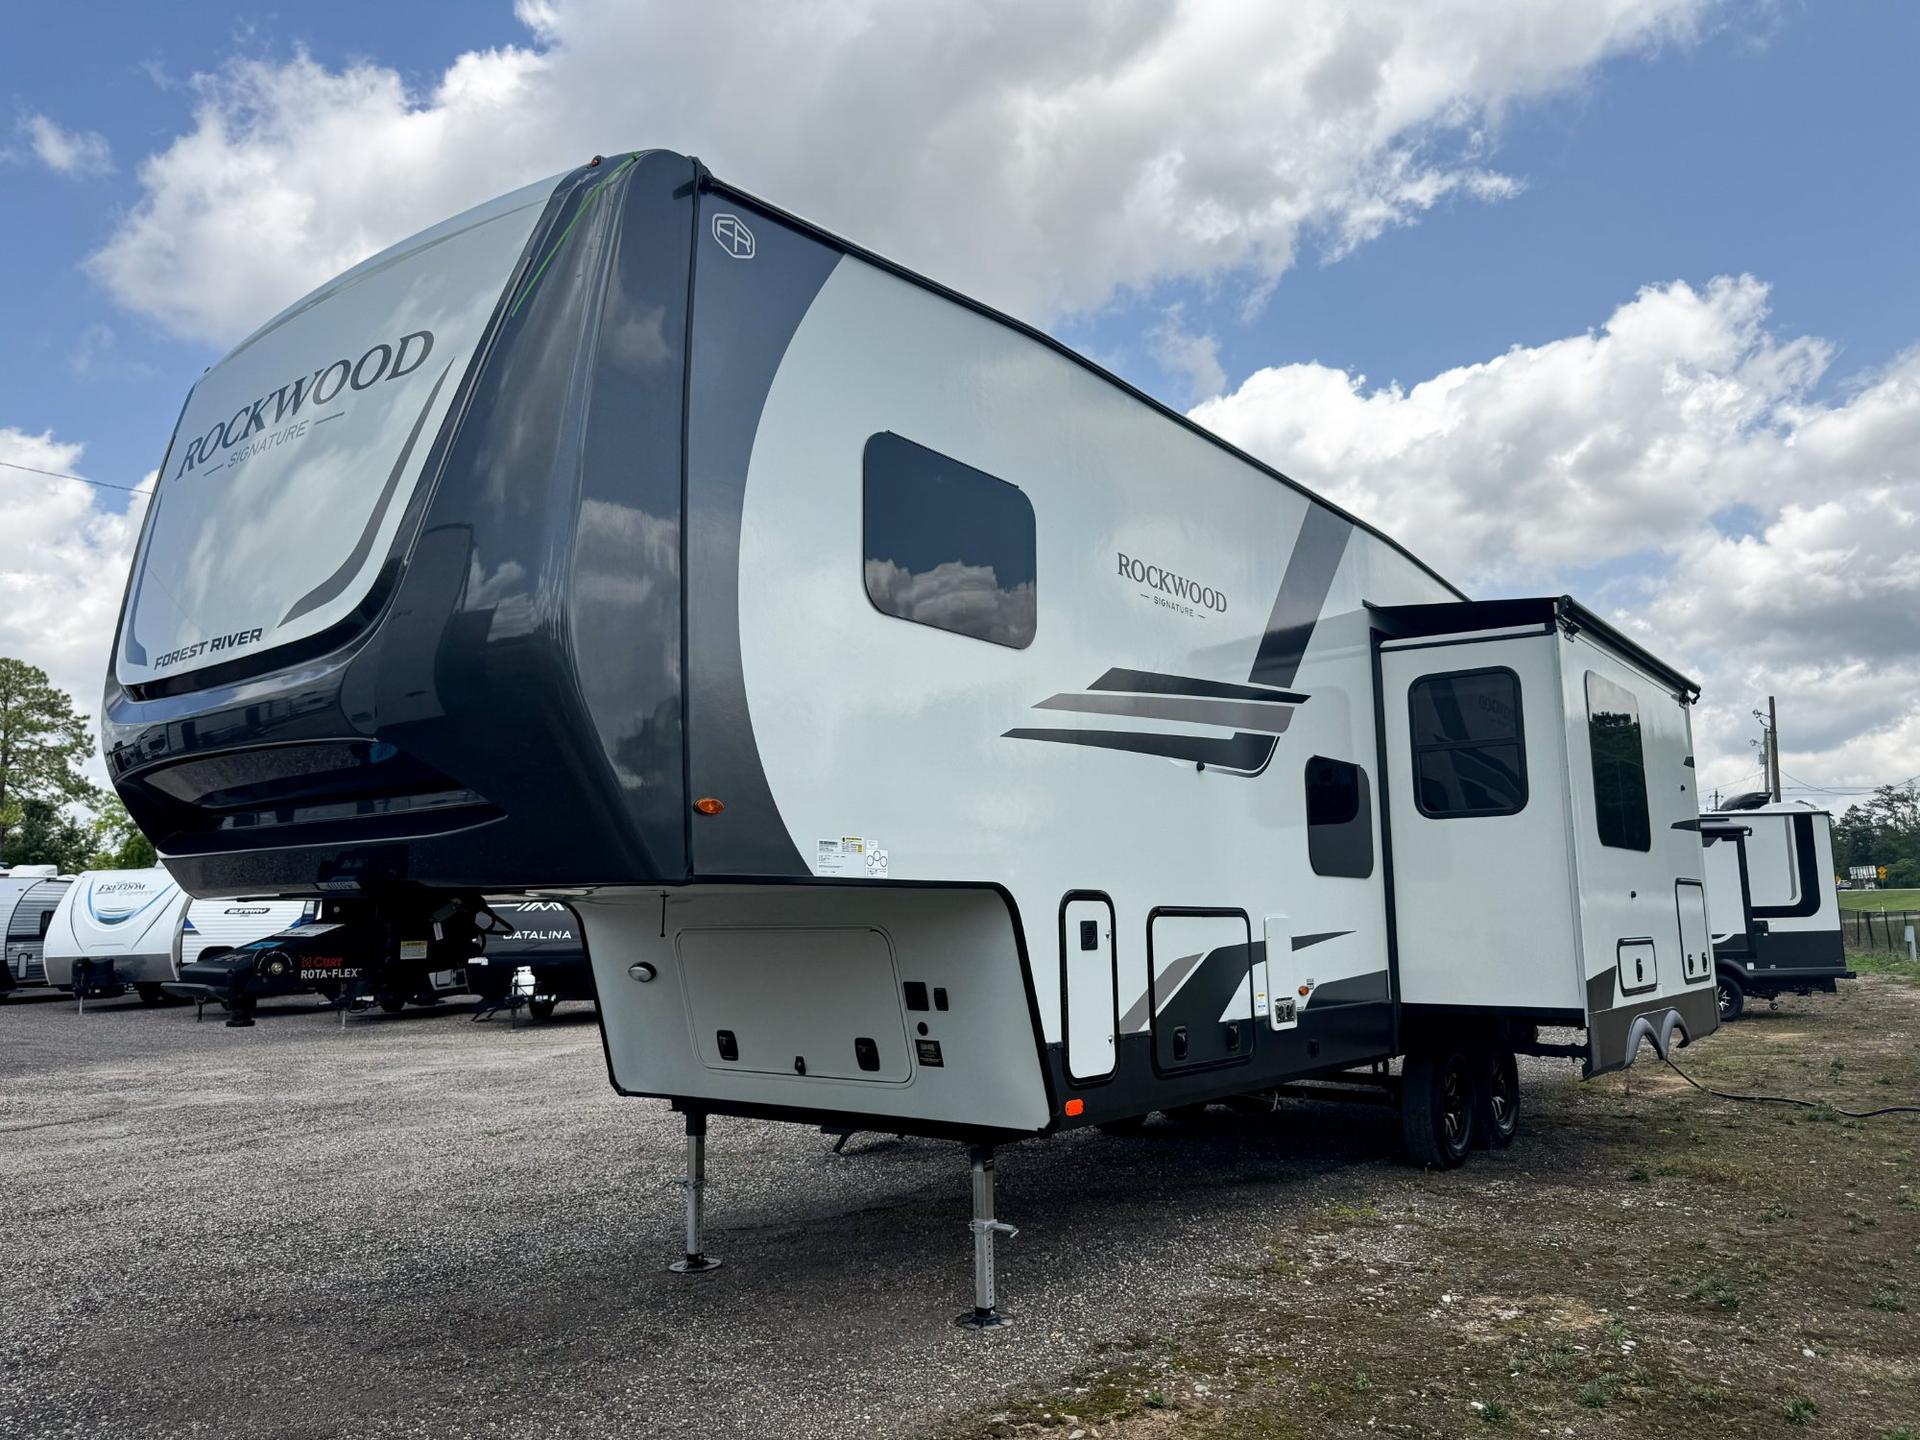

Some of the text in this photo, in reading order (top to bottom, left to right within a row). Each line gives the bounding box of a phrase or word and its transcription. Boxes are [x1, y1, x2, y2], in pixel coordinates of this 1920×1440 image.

[175, 330, 434, 481] ROCKWOOD
[227, 419, 310, 468] SIGNATURE
[1117, 552, 1227, 613] ROCKWOOD
[1153, 595, 1194, 617] SIGNATURE
[154, 628, 262, 671] FOREST RIVER
